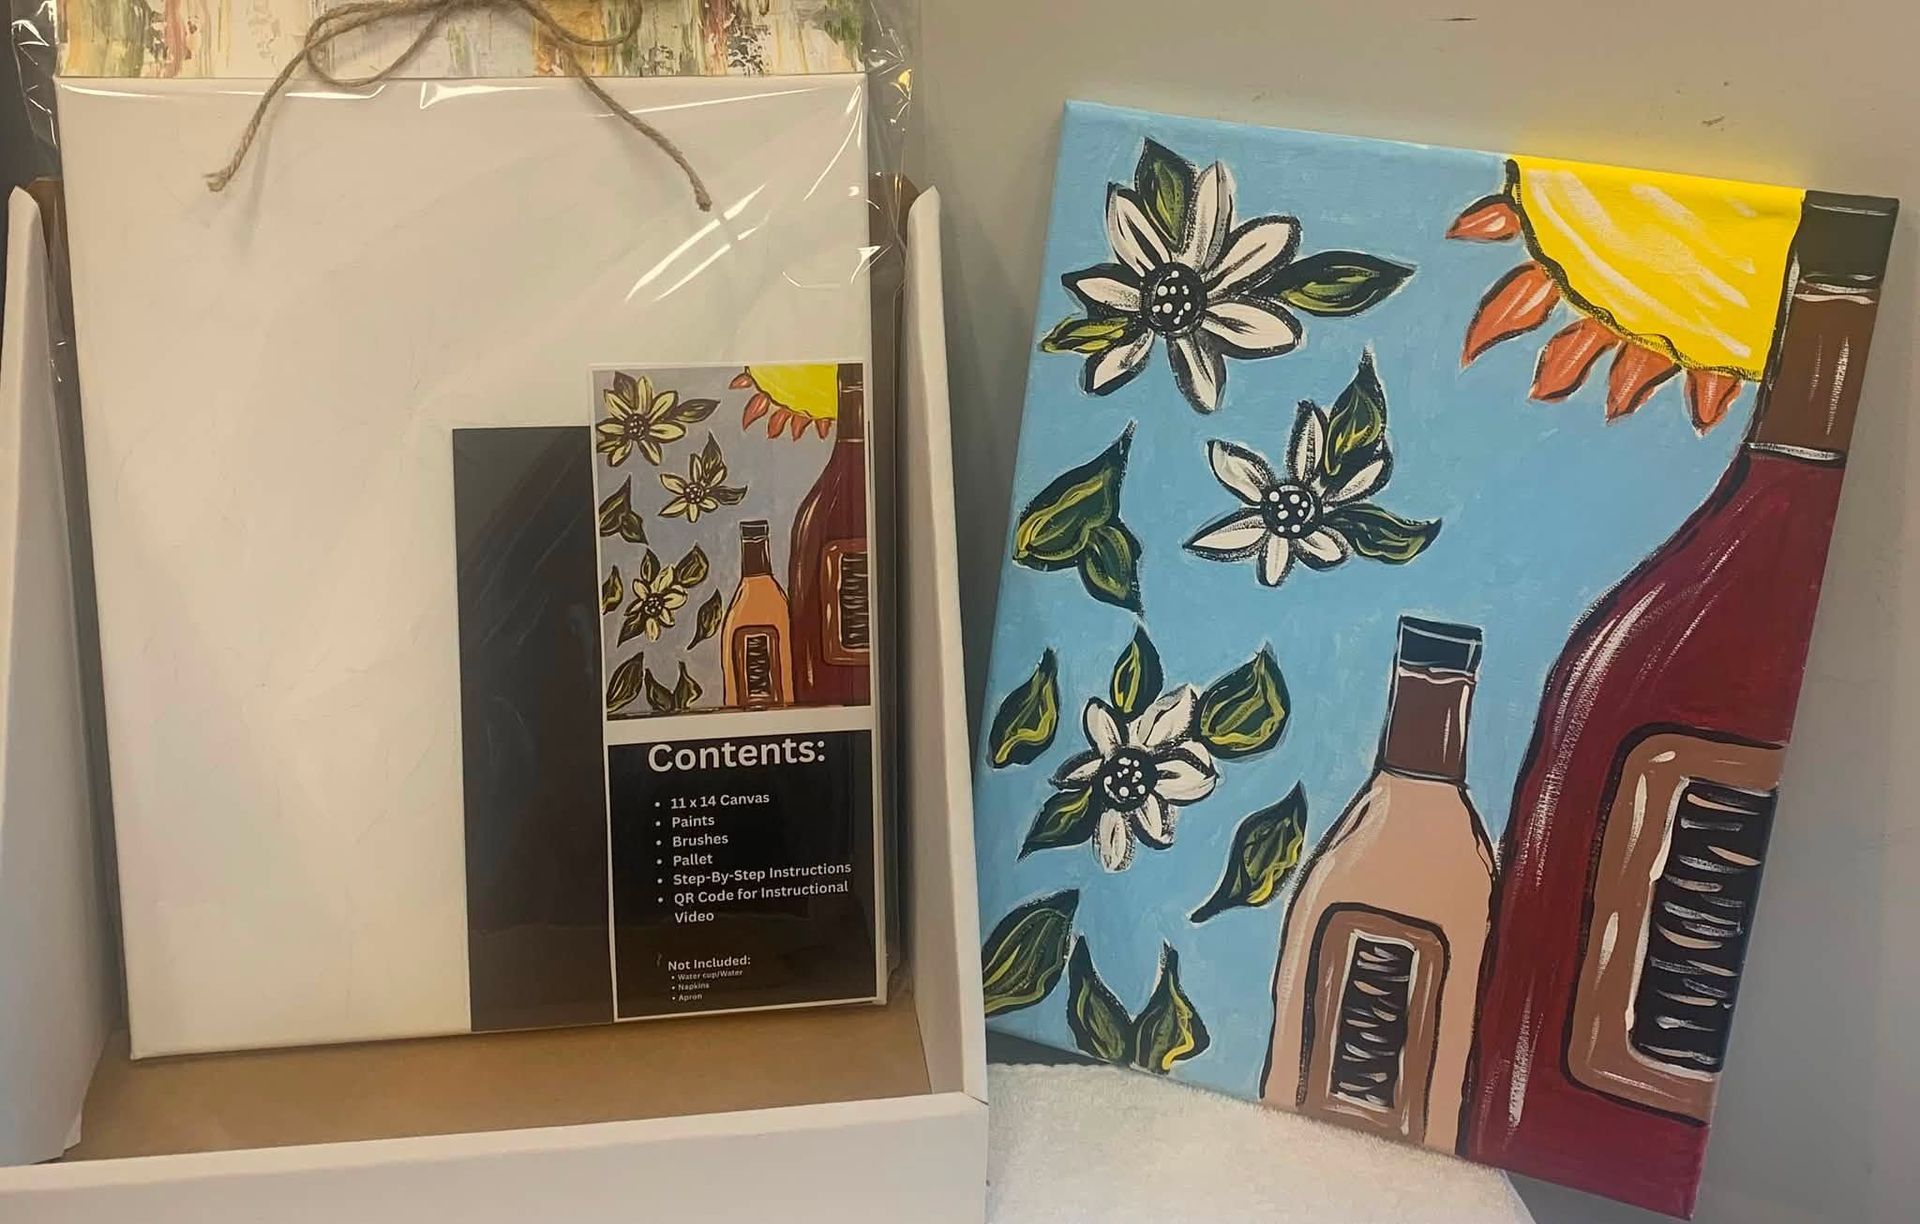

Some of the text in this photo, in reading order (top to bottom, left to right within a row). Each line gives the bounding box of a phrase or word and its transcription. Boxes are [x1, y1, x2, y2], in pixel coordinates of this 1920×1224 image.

[649, 738, 825, 772] Contents:
[671, 793, 770, 810] 11 x 14 Canvas
[672, 816, 715, 828] Paints
[672, 834, 729, 848] Brushes
[673, 854, 713, 866] Pallet
[673, 863, 851, 886] Step-By-Step Instructions
[674, 881, 848, 905] QR Code for Instructional
[675, 911, 714, 923] Video
[668, 955, 751, 971] Not Included:
[702, 970, 743, 979] cup/Water
[678, 983, 710, 991] Napkins
[678, 994, 702, 1002] Apron
